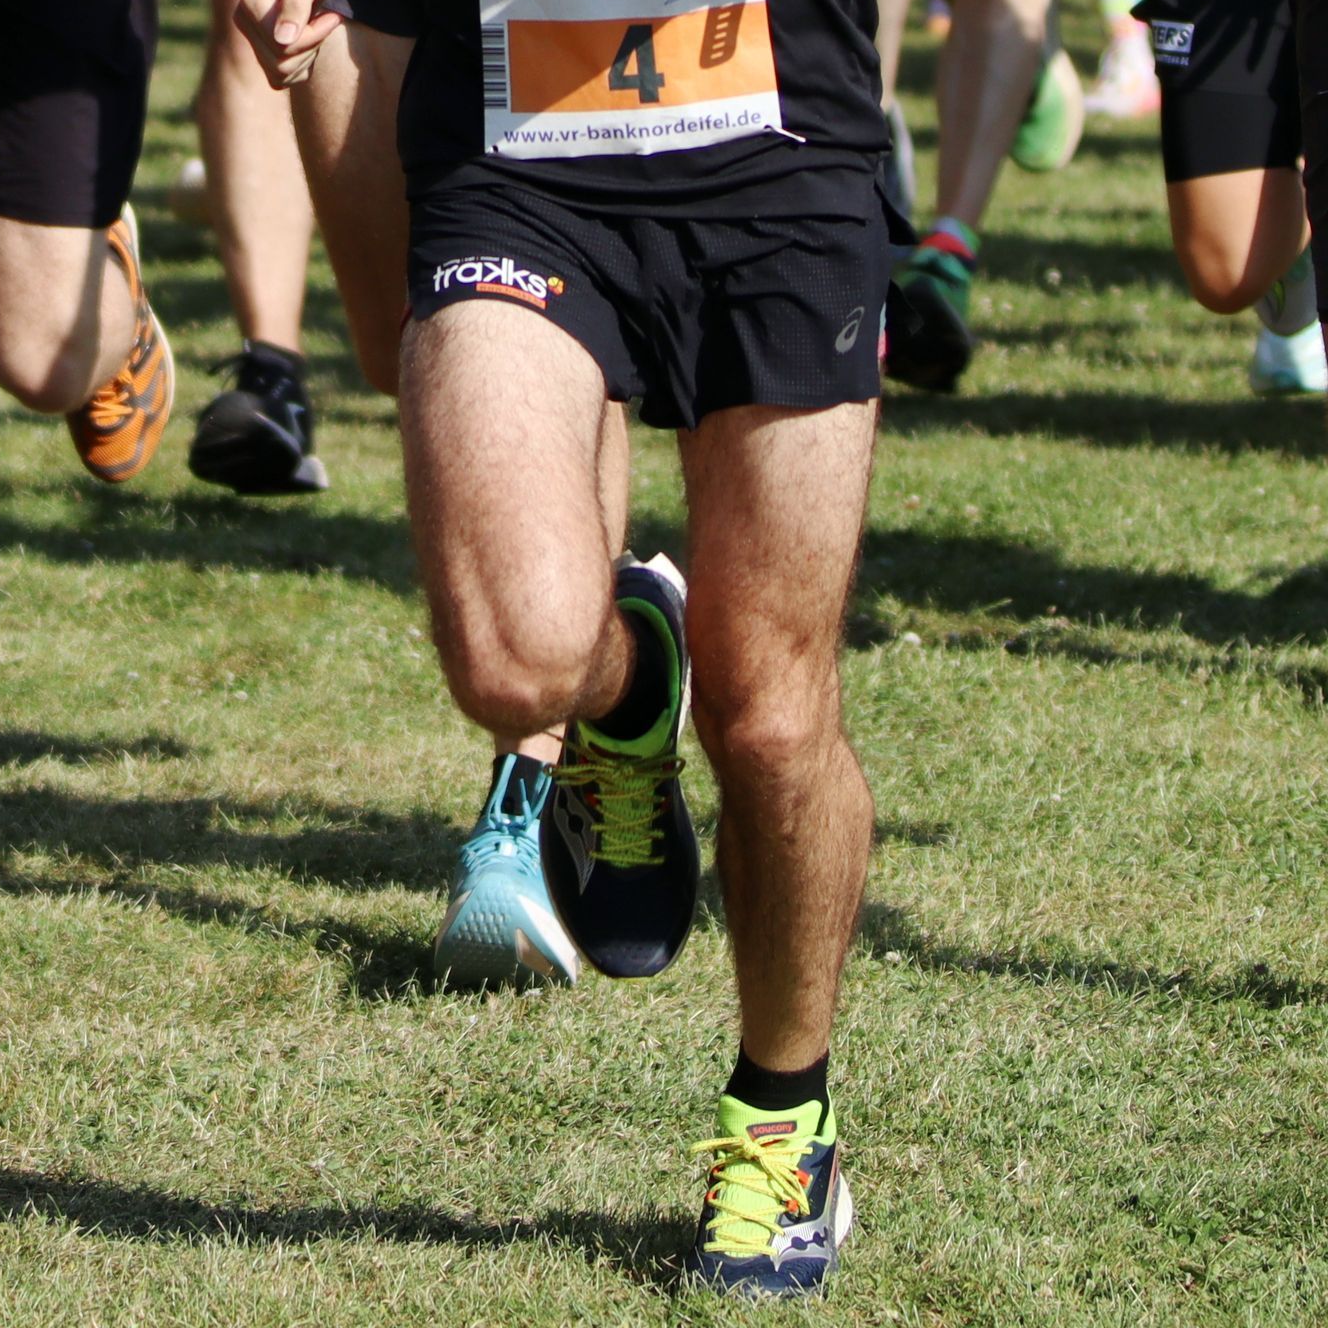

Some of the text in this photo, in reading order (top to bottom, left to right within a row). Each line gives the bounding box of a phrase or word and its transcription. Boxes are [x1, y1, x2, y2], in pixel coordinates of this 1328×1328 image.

[608, 24, 665, 104] 4
[504, 110, 762, 143] www.vr-banknordeifel.de
[433, 257, 548, 299] trakks
[752, 1123, 794, 1135] saucony
